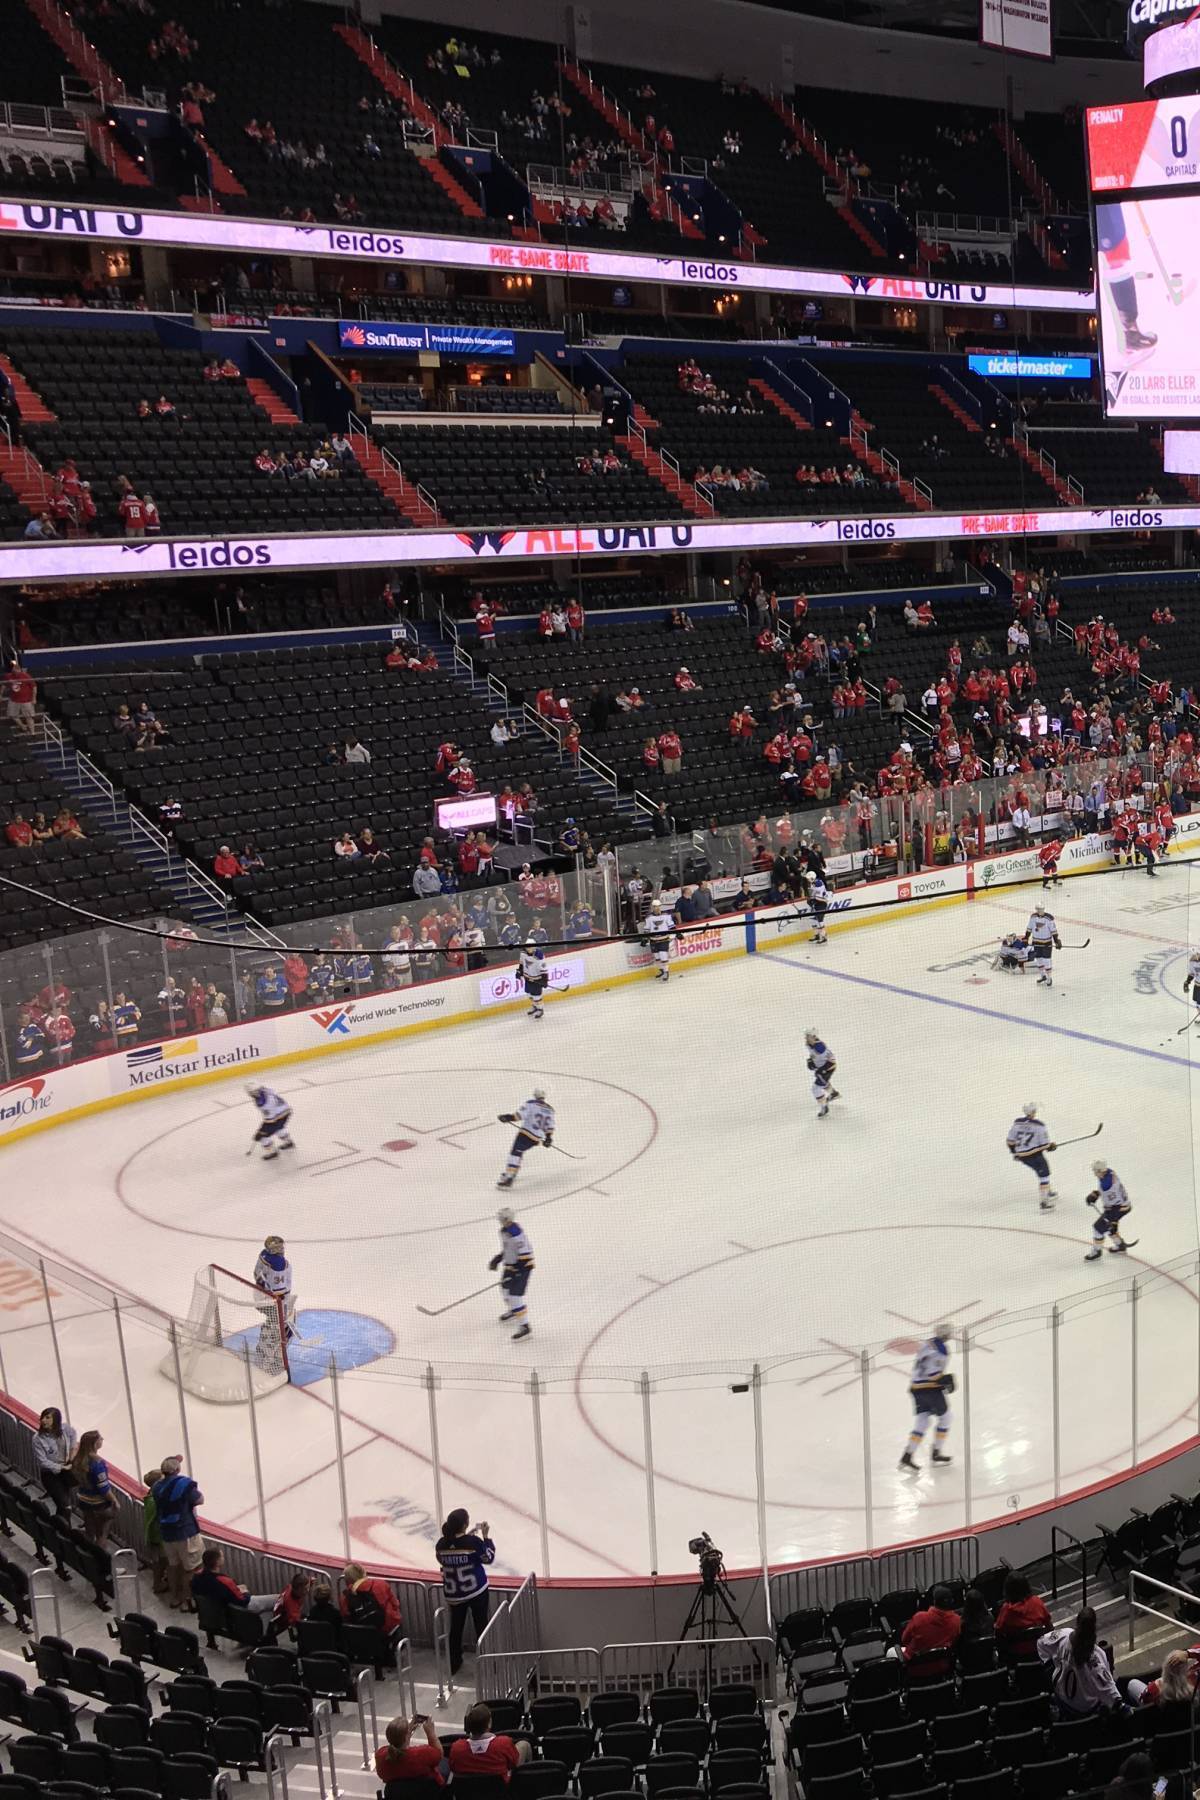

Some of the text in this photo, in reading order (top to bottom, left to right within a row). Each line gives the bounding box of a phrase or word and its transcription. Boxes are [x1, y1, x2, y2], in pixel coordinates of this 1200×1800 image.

[1090, 108, 1124, 125] PENALTY
[1170, 115, 1187, 158] 0
[1165, 163, 1197, 177] CAPITALS
[328, 229, 404, 254] leidos
[489, 246, 590, 272] PRE-GAME SKATE
[681, 260, 738, 282] leidos
[431, 334, 513, 347] Private Wealth Management
[988, 358, 1069, 376] ticketmaster
[1129, 376, 1196, 390] 20 LARS ELLER
[962, 512, 1040, 534] PRE-GAME SKATE
[1110, 508, 1163, 527] leidos
[837, 519, 896, 540] leidos
[168, 541, 271, 568] leidos
[1005, 857, 1033, 873] Greene
[914, 879, 946, 894] TOYOTA
[678, 938, 722, 956] DONUTS
[348, 995, 446, 1025] World Wide Technology
[129, 1043, 261, 1088] MedStar Health
[0, 1094, 52, 1122] talOne
[1015, 1131, 1035, 1147] 57
[443, 1564, 478, 1594] 55
